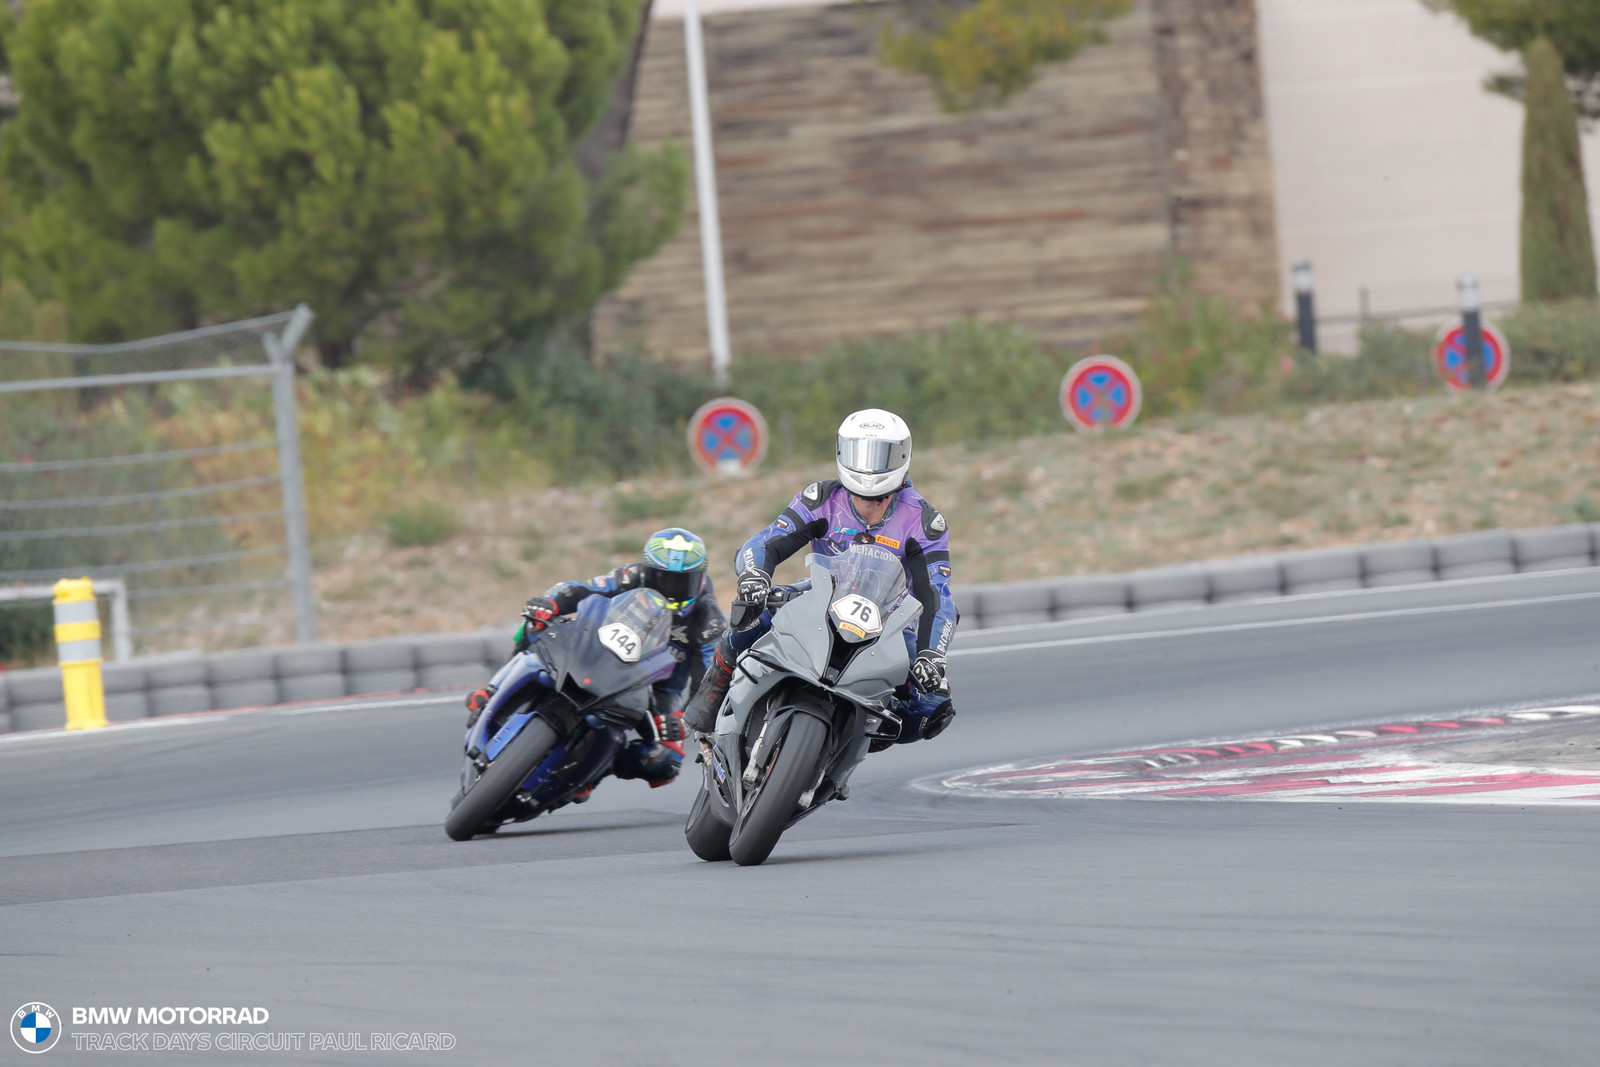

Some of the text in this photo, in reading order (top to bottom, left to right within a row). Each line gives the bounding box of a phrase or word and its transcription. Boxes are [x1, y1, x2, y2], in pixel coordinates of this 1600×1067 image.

[876, 536, 898, 548] PIRELLI
[850, 601, 872, 622] 76
[610, 629, 636, 655] 144
[936, 619, 953, 655] RACIOUS
